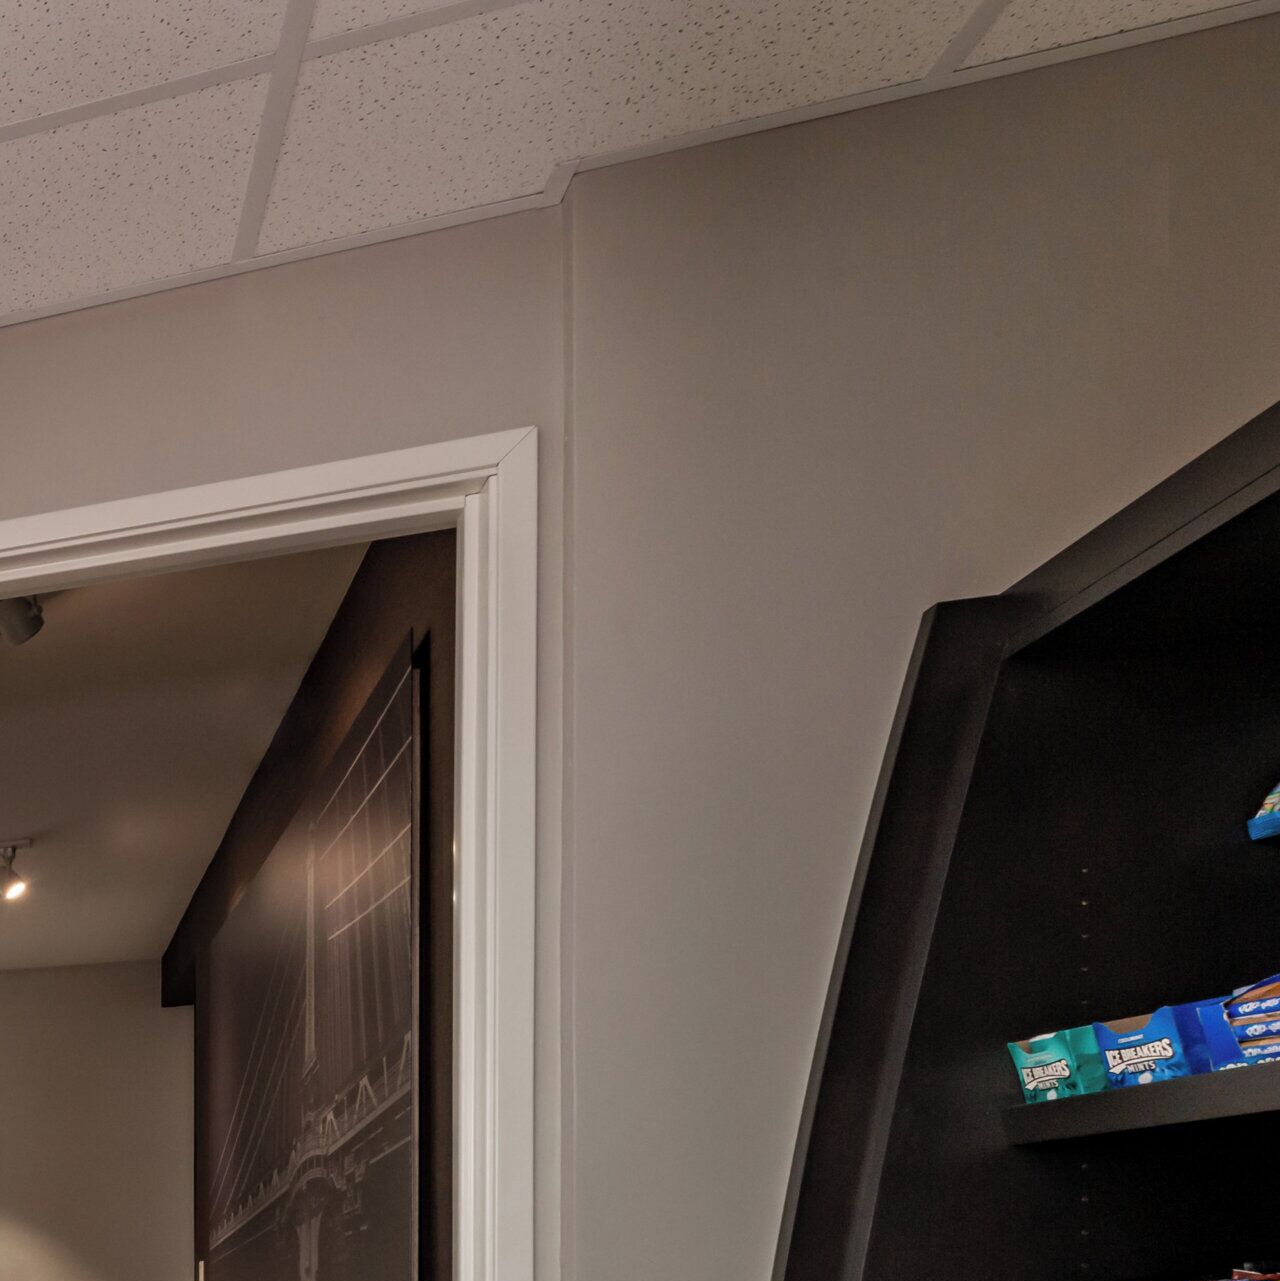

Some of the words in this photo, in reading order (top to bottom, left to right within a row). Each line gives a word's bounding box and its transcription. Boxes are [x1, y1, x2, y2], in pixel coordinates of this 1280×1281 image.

[1105, 1049, 1121, 1067] ICE
[1121, 1038, 1174, 1060] BREAKERS
[1033, 1060, 1069, 1079] BREAKERS
[1128, 1061, 1156, 1073] MINTS
